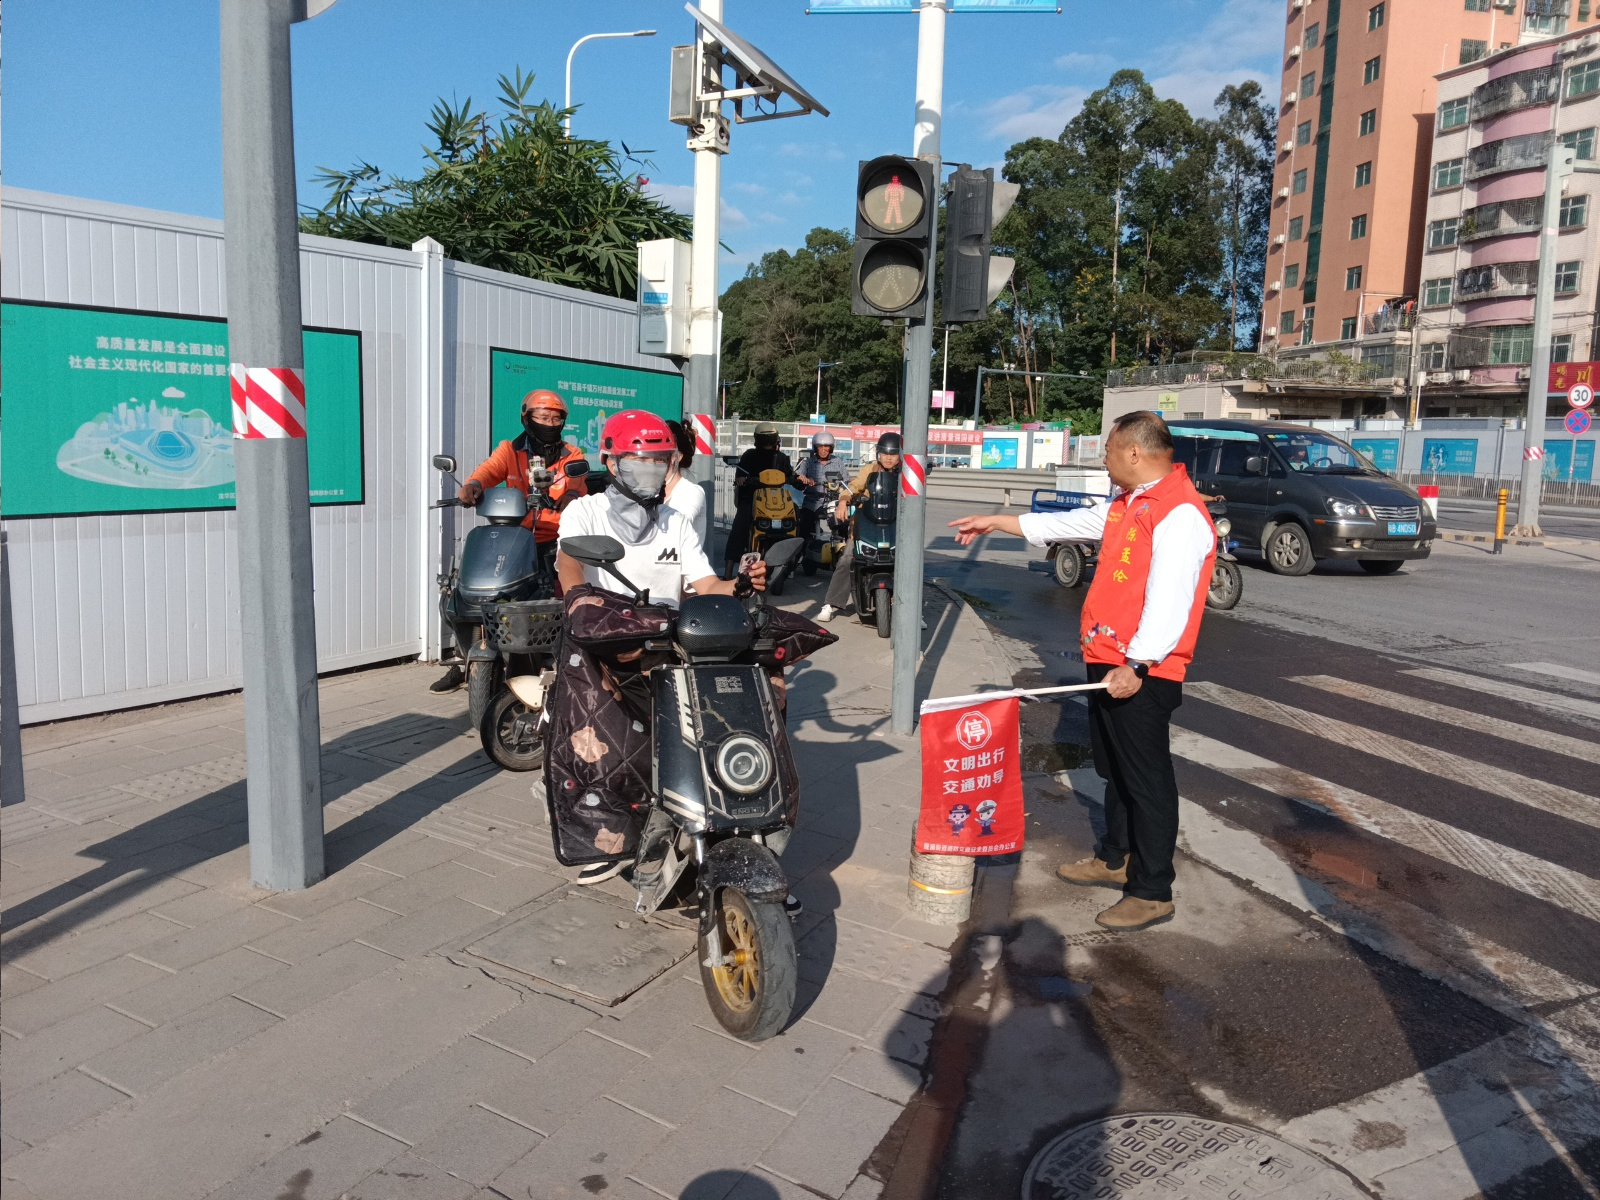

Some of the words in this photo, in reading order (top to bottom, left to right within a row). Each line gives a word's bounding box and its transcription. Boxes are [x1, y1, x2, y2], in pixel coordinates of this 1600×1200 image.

[96, 336, 226, 358] 高质量发展是全面建设
[68, 355, 231, 377] 社会主义现代化国家的首要
[1573, 389, 1589, 402] 30
[963, 718, 986, 744] 停
[943, 746, 1005, 774] 文明出行
[942, 768, 1004, 796] 交通劝导
